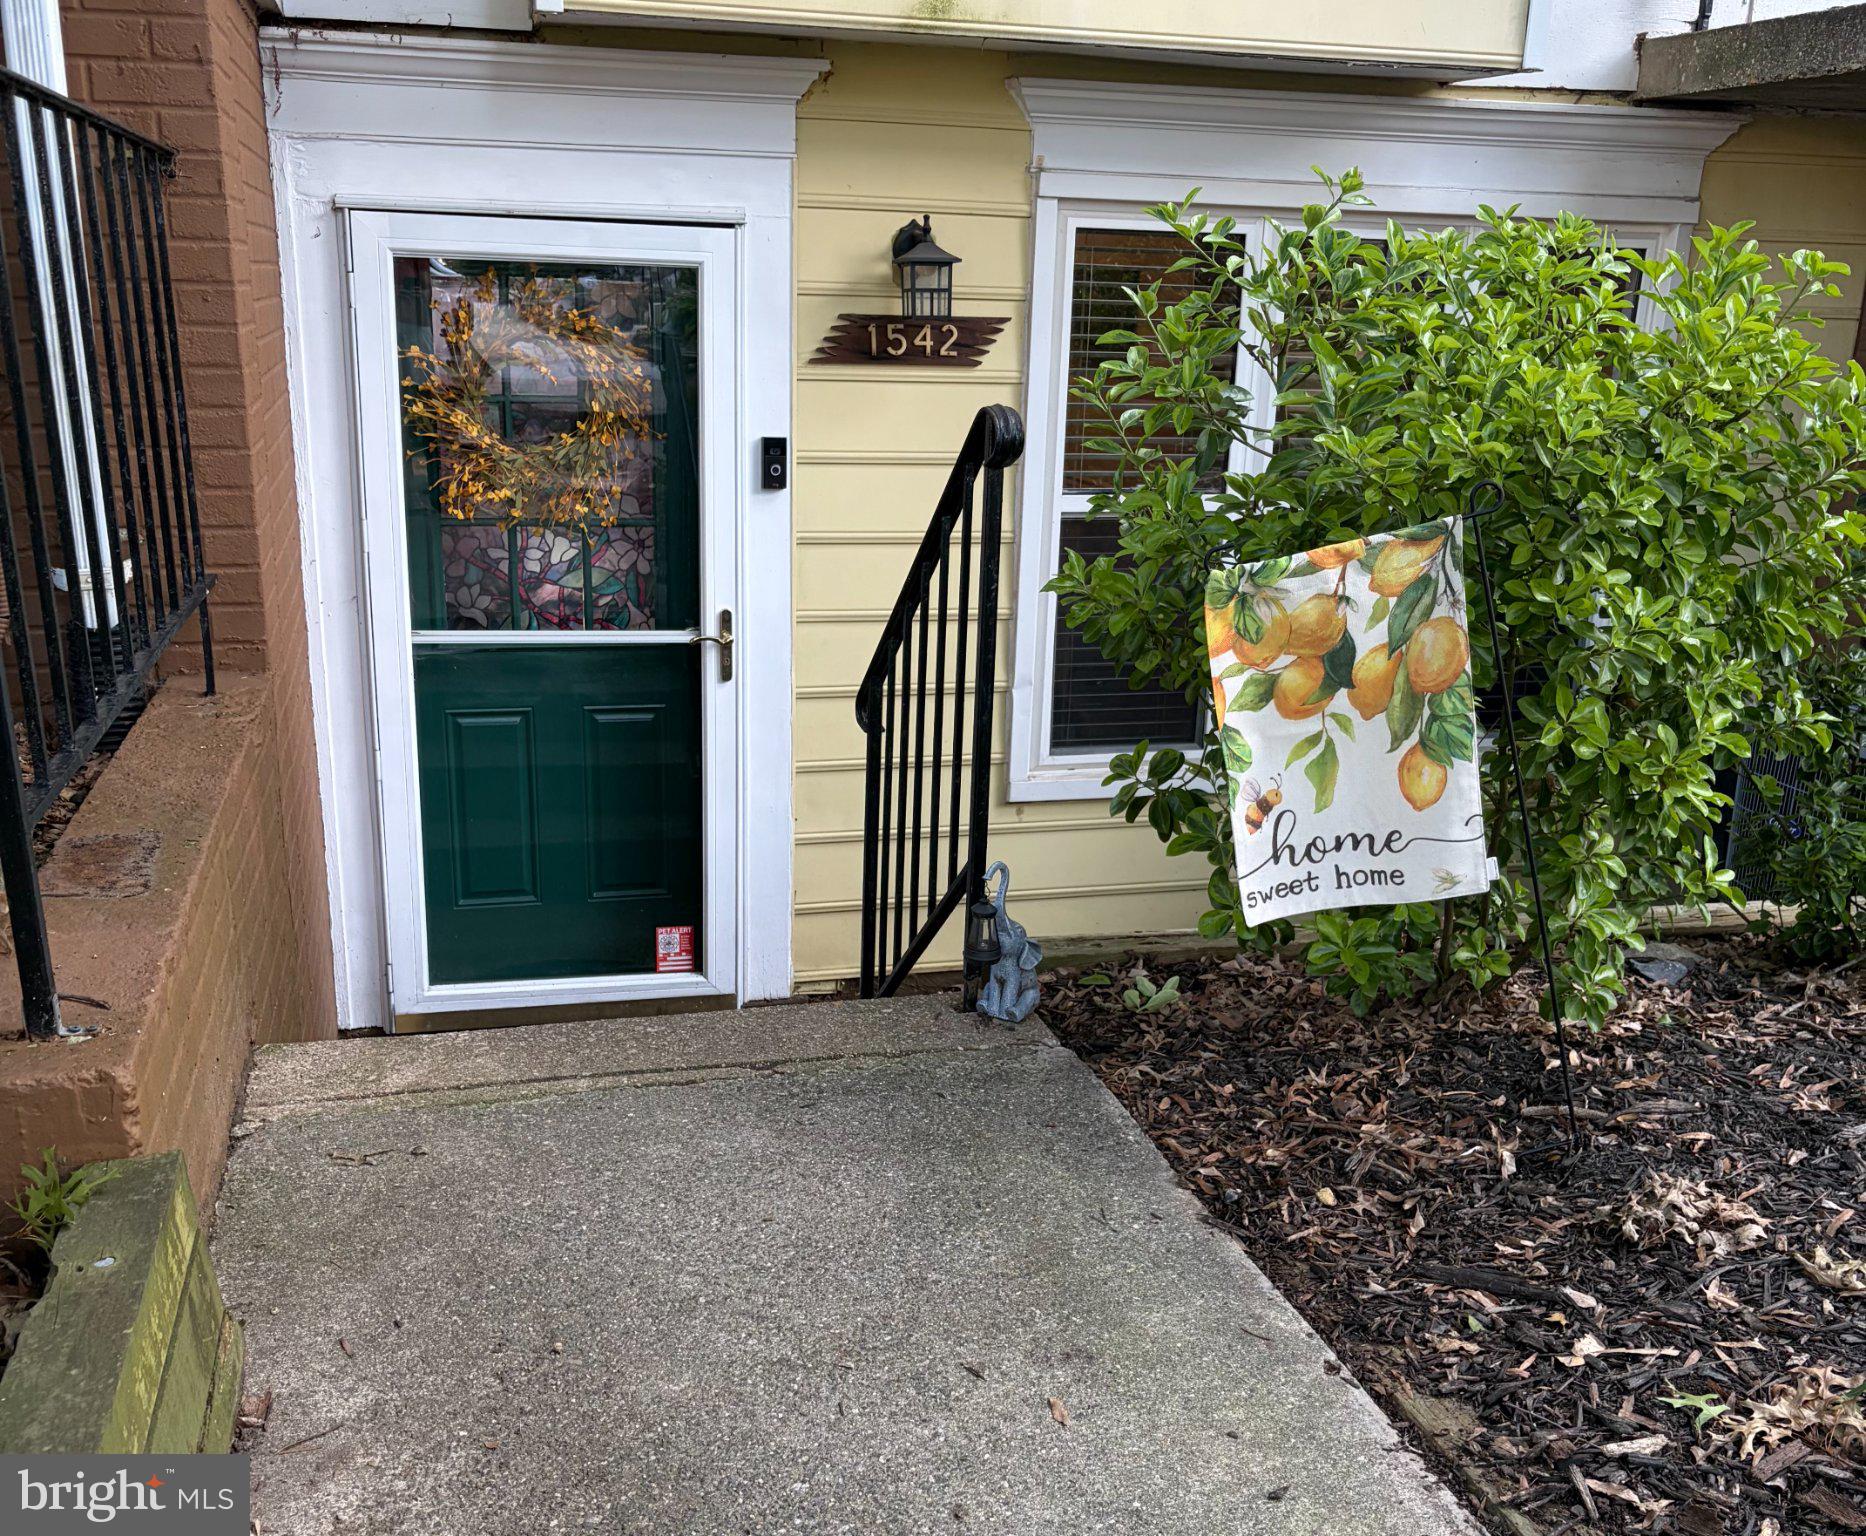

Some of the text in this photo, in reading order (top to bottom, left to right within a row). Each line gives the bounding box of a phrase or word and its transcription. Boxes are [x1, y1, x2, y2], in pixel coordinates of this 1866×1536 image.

[867, 323, 958, 357] 1542
[1258, 809, 1420, 867] home
[1246, 863, 1405, 909] sweet home
